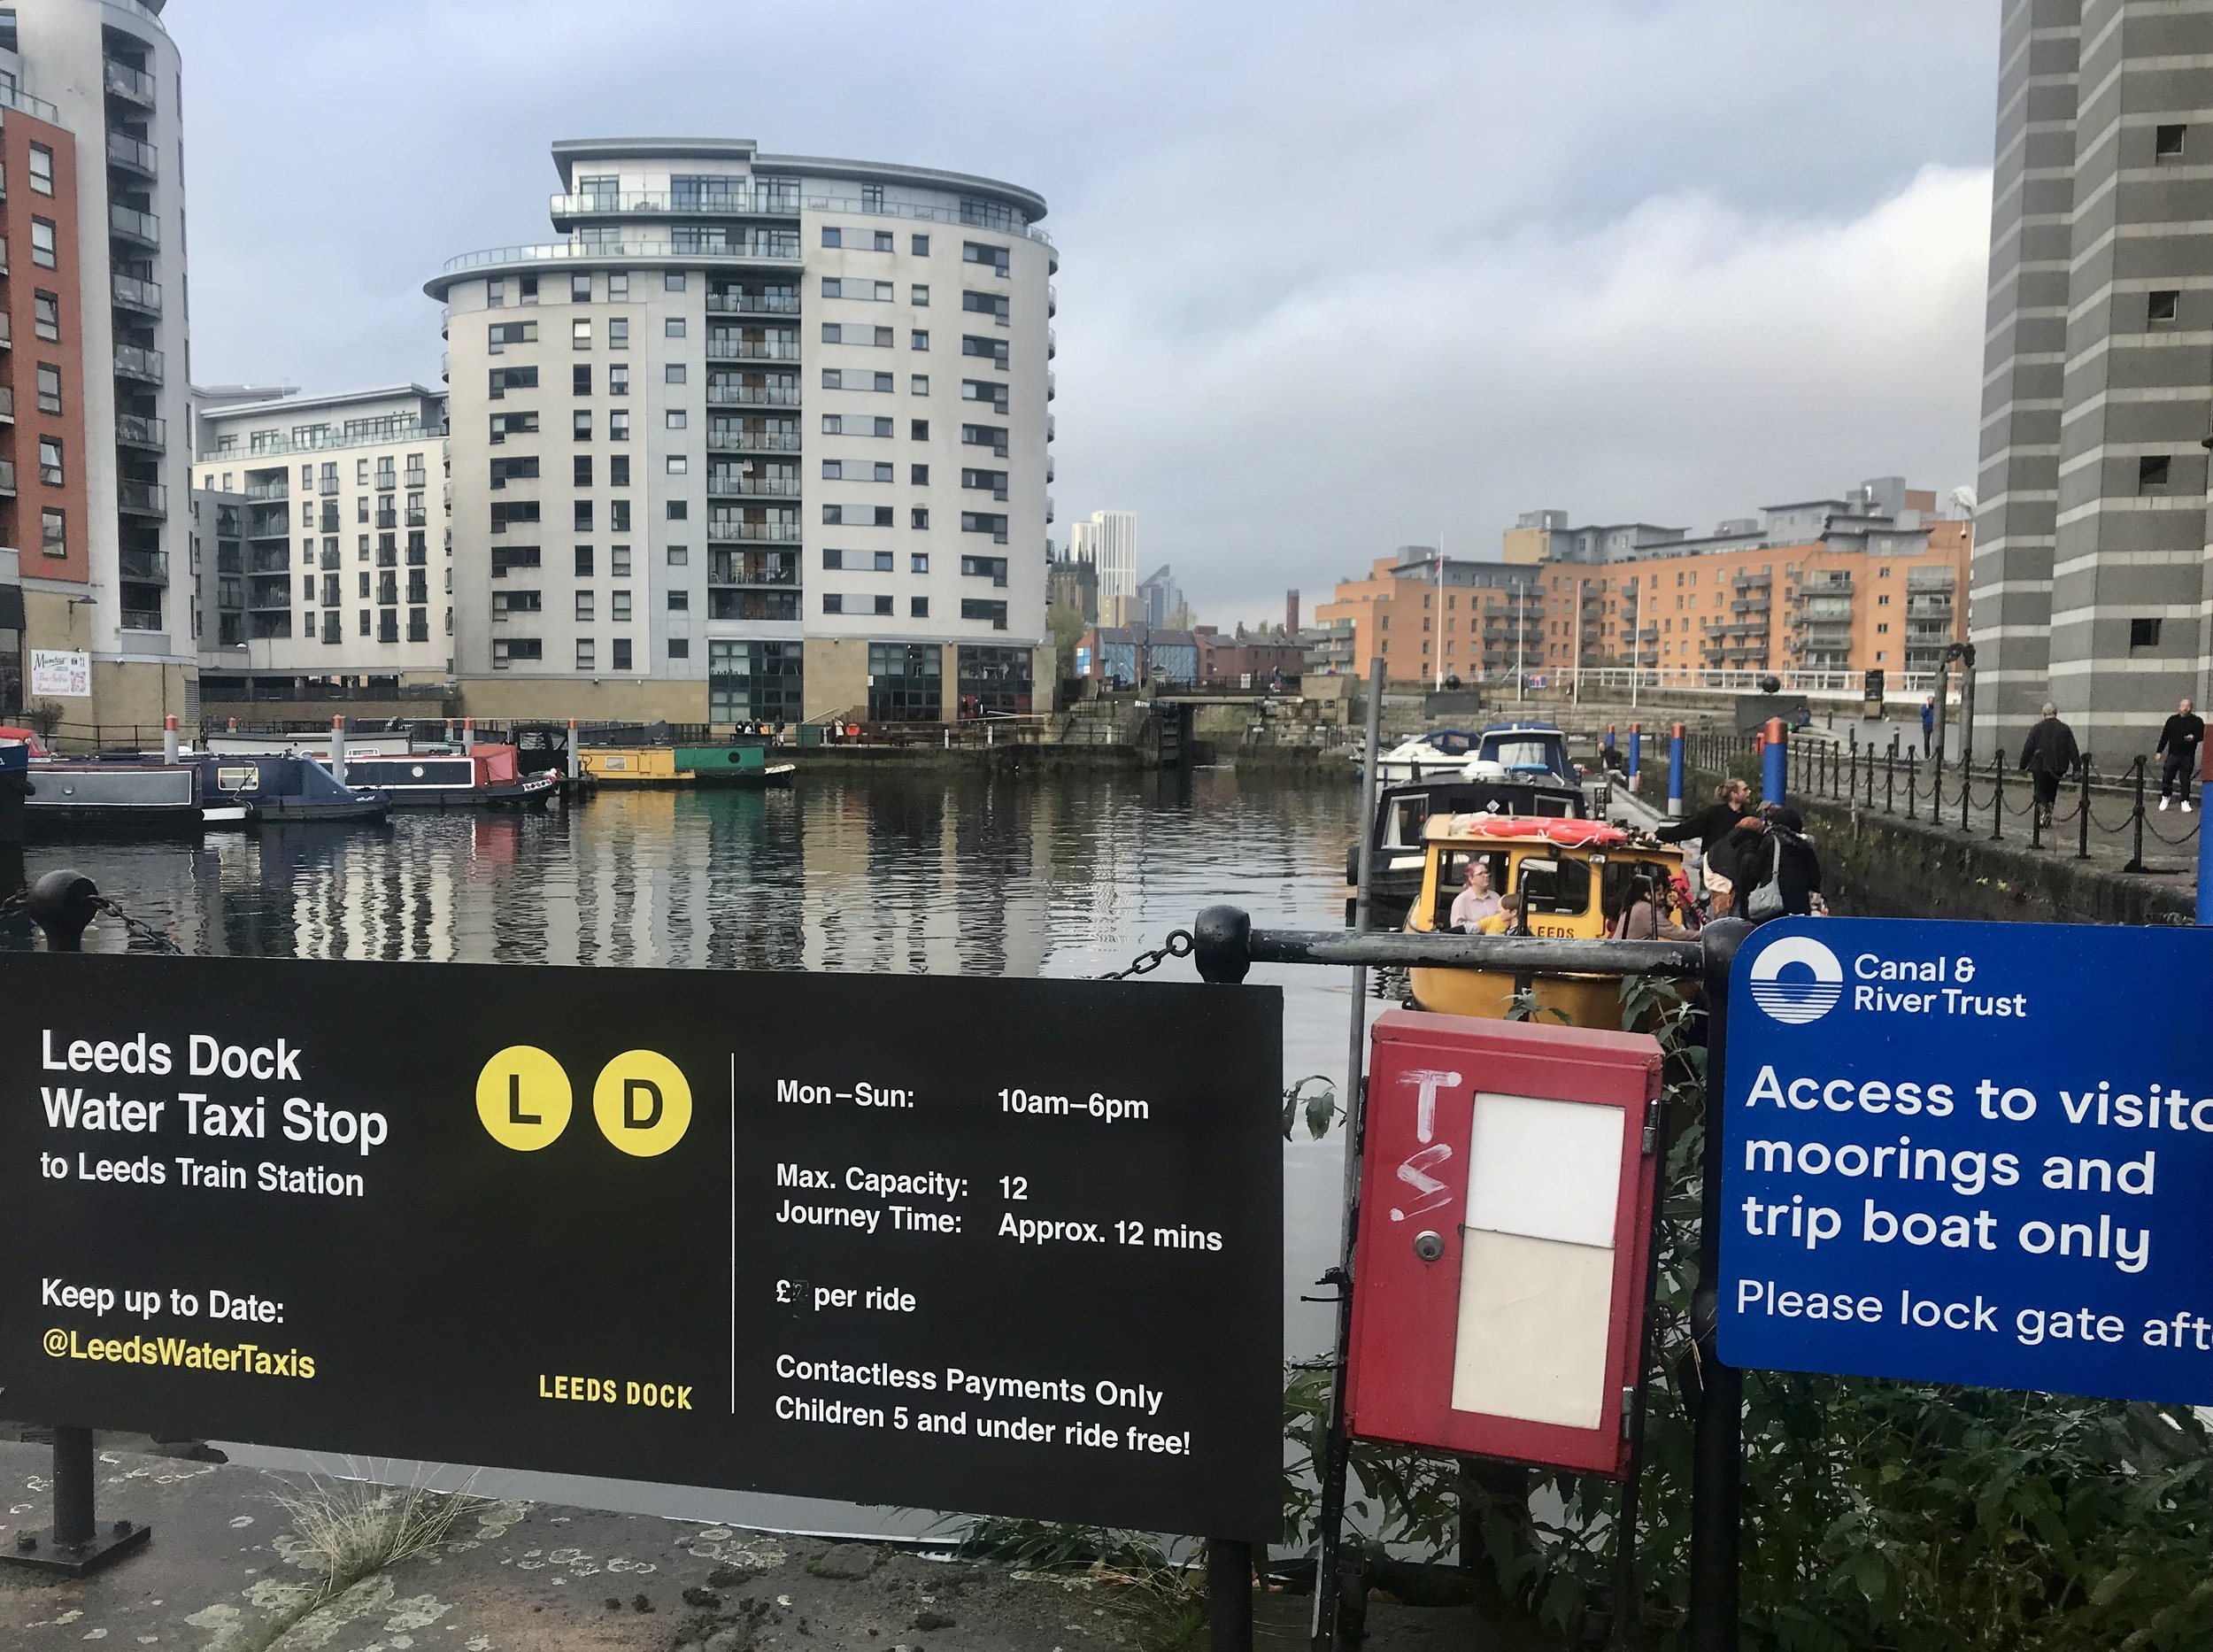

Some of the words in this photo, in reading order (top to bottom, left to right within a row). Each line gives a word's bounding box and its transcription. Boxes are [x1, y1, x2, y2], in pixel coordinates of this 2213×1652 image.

[1529, 924, 1574, 938] EEDS
[1854, 953, 1945, 981] Canal
[1955, 957, 1975, 983] &
[1855, 986, 1937, 1012] River
[1942, 989, 2026, 1016] Trust
[42, 1030, 172, 1075] Leeds
[189, 1035, 302, 1080] Dock
[510, 1075, 541, 1124] L
[624, 1079, 663, 1129] D
[1746, 1066, 1954, 1116] Access
[1976, 1079, 2036, 1121] to
[41, 1087, 165, 1132] Water
[179, 1093, 265, 1138] Taxi
[283, 1098, 388, 1155] Stop
[41, 1152, 68, 1178] to
[79, 1153, 166, 1184] Leeds
[175, 1157, 246, 1189] Train
[258, 1162, 363, 1196] Station
[777, 1163, 836, 1188] Max.
[846, 1167, 967, 1201] Capacity:
[999, 1176, 1027, 1200] 12
[1746, 1136, 2019, 1195] moorings
[2043, 1151, 2155, 1194] and
[776, 1200, 880, 1233] Journey
[889, 1206, 960, 1232] Time:
[999, 1213, 1105, 1245] Approx.
[1114, 1221, 1144, 1245] 12
[1154, 1224, 1222, 1250] mins
[1742, 1195, 1841, 1249] trip
[1863, 1200, 1997, 1250] boat
[2019, 1215, 2149, 1272] only
[42, 1278, 114, 1316] Keep
[125, 1291, 160, 1320] up
[170, 1289, 198, 1316] to
[210, 1290, 283, 1323] Date:
[815, 1288, 857, 1311] per
[867, 1286, 915, 1311] ride
[1739, 1279, 1883, 1322] Please
[1901, 1290, 1998, 1332] lock
[2016, 1308, 2124, 1345] gate
[2143, 1312, 2213, 1350] aft
[43, 1329, 315, 1378] @LeedsWaterTaxis
[540, 1375, 616, 1402] LEEDS
[627, 1382, 692, 1409] DOCK
[776, 1355, 937, 1390] Contactless
[947, 1369, 1085, 1402] Payments
[1096, 1381, 1163, 1415] Only
[776, 1395, 883, 1427] Children
[894, 1407, 908, 1429] 5
[918, 1411, 966, 1434] and
[977, 1417, 1055, 1442] under
[1066, 1422, 1118, 1448] ride
[1127, 1426, 1190, 1455] free!
